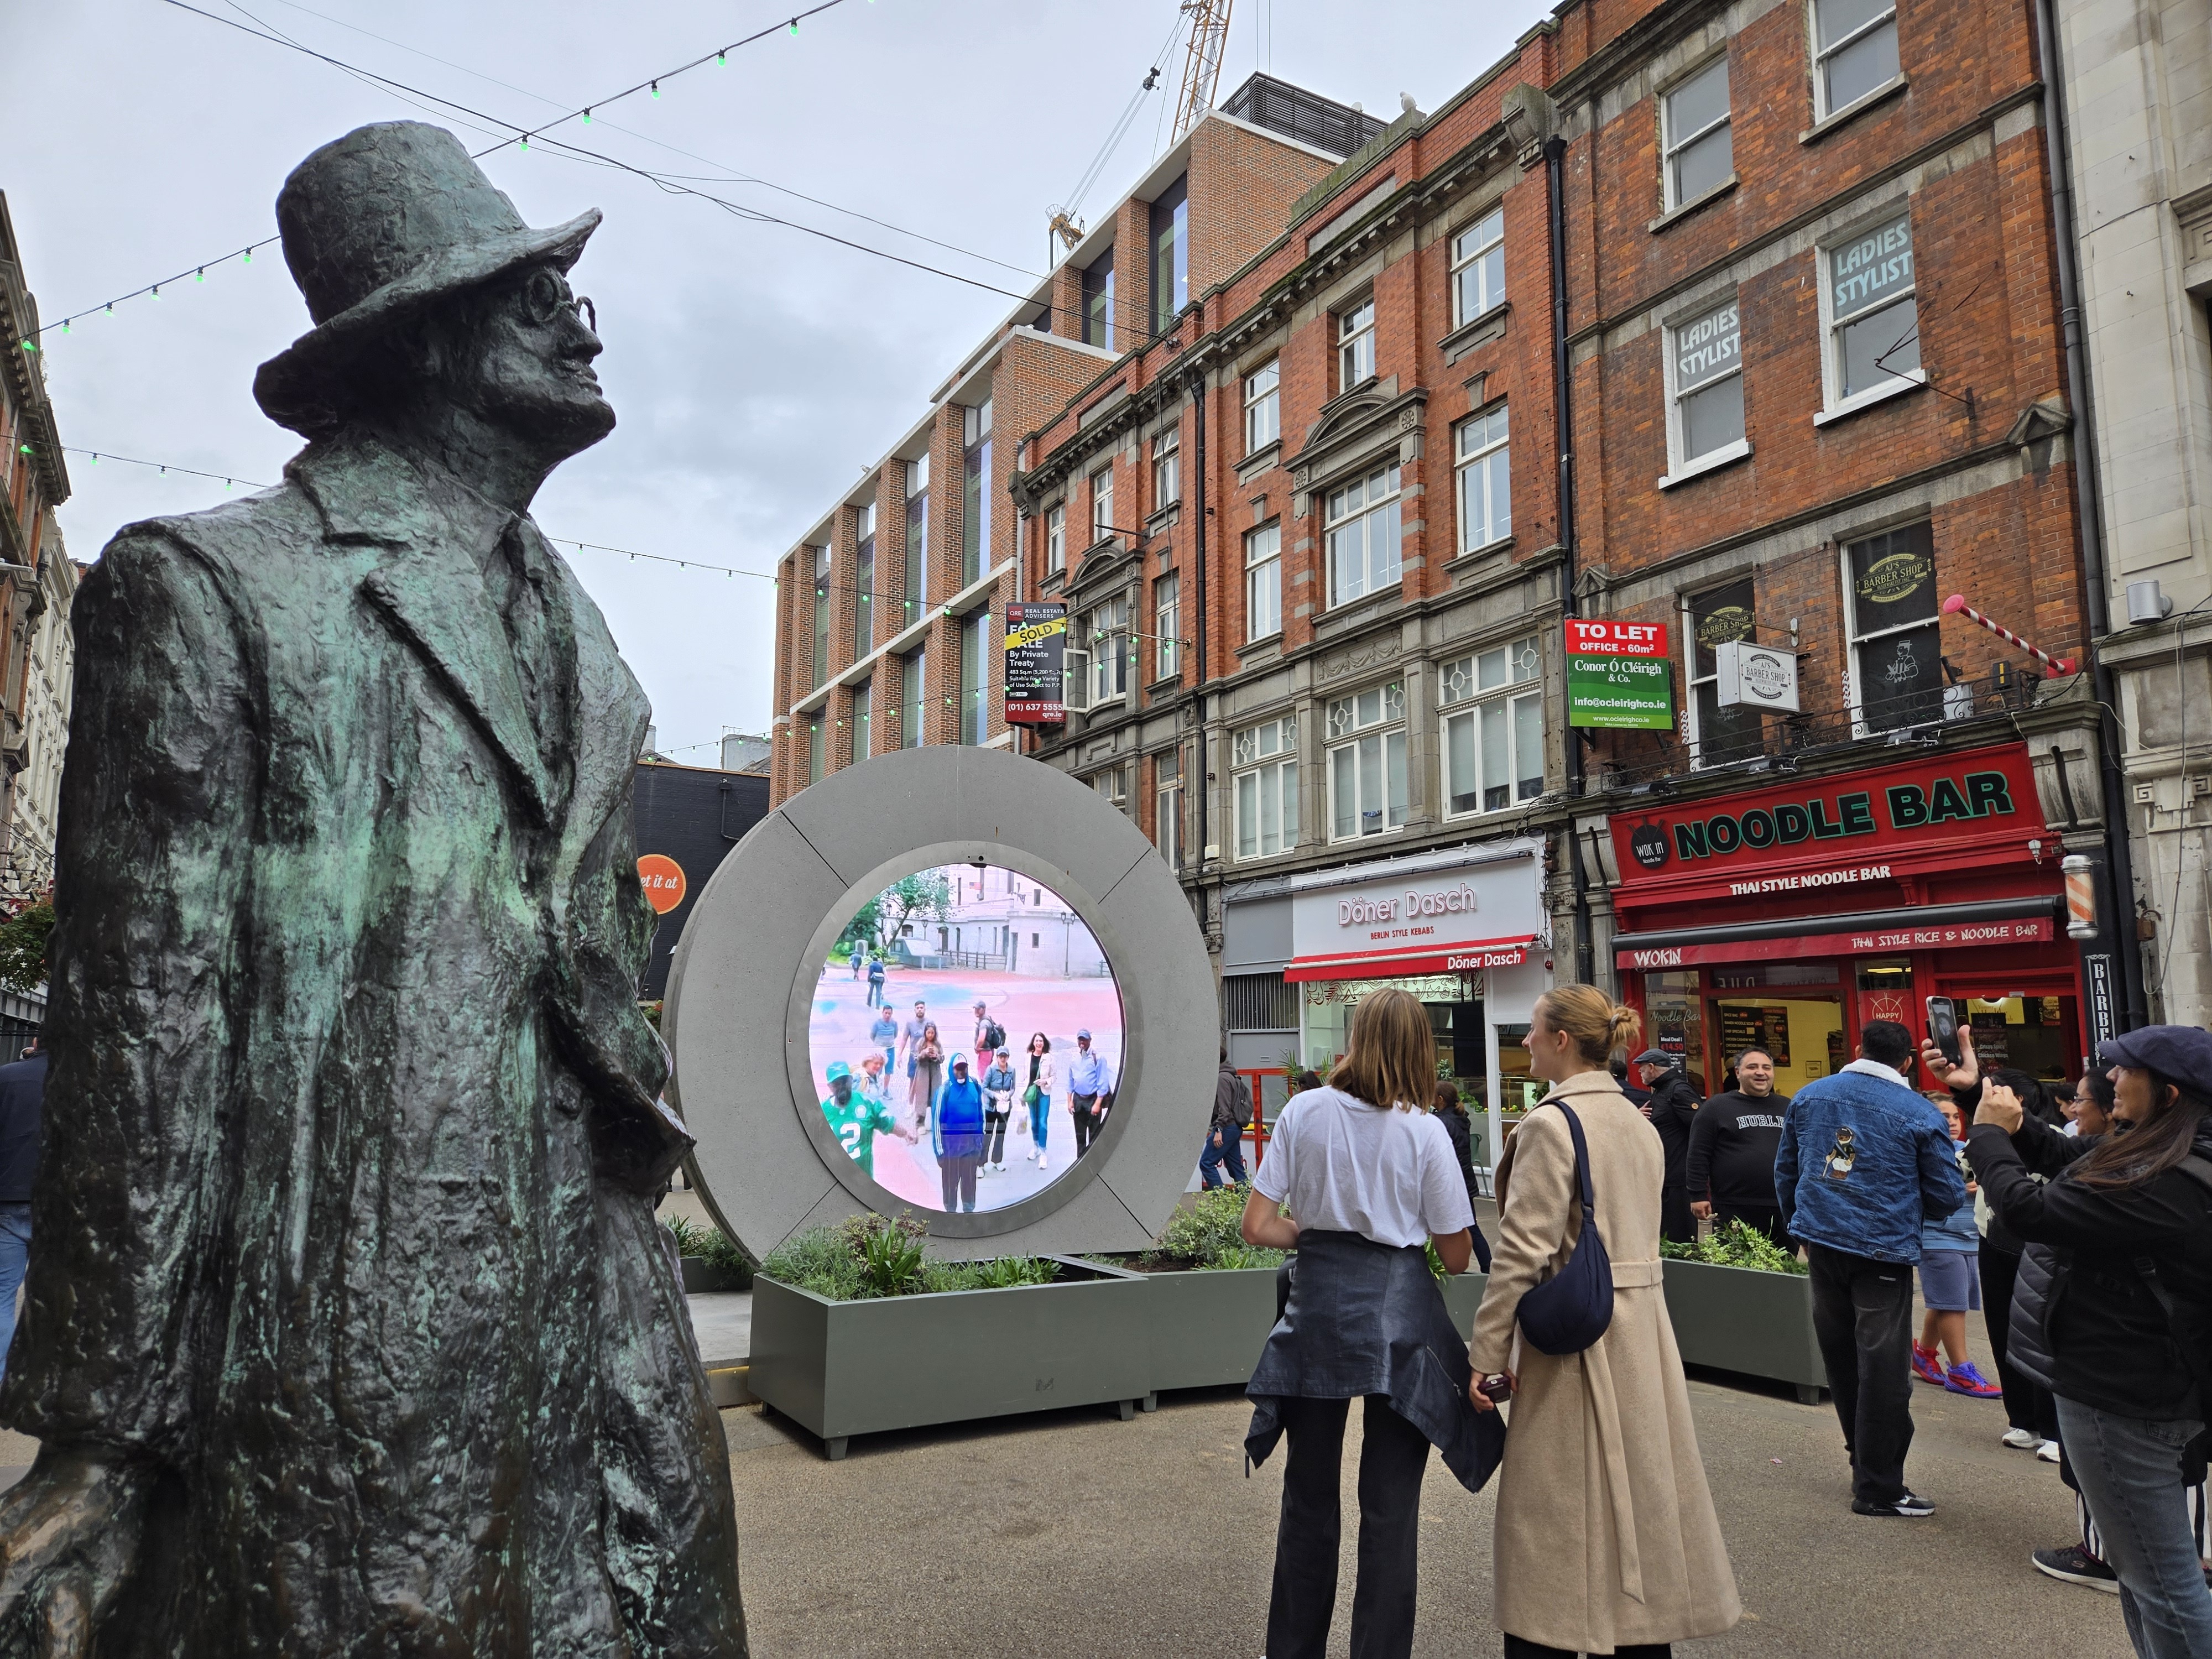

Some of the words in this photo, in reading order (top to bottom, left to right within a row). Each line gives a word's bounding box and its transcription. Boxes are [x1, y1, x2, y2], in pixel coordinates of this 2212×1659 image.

[1837, 222, 1908, 276] LADIES
[1835, 251, 1912, 307] STYLIST
[1680, 305, 1738, 352] LADIES
[1679, 332, 1740, 375] STYLIST
[1885, 561, 1900, 572] AJ'S
[1864, 571, 1897, 589] BARBER
[1900, 563, 1923, 578] SHOP
[1019, 625, 1052, 643] SOLD
[1574, 624, 1606, 638] TO
[1614, 625, 1657, 640] LET
[1701, 622, 1729, 637] BARBER
[1730, 615, 1749, 628] SHOP
[1010, 650, 1019, 659] By
[1580, 643, 1619, 651] OFFICE
[1627, 644, 1654, 653] 60m²
[1009, 659, 1034, 667] Treaty
[1575, 660, 1606, 671] Conor
[1609, 658, 1619, 672] Ó
[1621, 662, 1662, 676] Cléirigh
[1609, 674, 1615, 682] &
[1618, 674, 1631, 682] Co.
[1746, 667, 1770, 680] BARBER
[1771, 672, 1786, 682] SHOP
[1008, 703, 1023, 712] (01)
[1574, 697, 1666, 709] info@ocleirighco.ie
[1673, 791, 1876, 860] NOODLE
[1885, 770, 2015, 829] BAR
[1636, 843, 1654, 857] WOK
[1655, 841, 1664, 854] IN
[653, 874, 664, 888] it
[665, 876, 678, 889] at
[1730, 881, 1760, 895] THAI
[1761, 877, 1799, 892] STYLE
[1801, 869, 1859, 887] NOODLE
[1860, 865, 1891, 880] BAR
[1338, 897, 1397, 926] Döner
[1405, 883, 1477, 917] Dasch
[1370, 931, 1390, 940] BERLIN
[1392, 929, 1408, 938] STYLE
[1411, 926, 1434, 936] KEBABS
[1851, 936, 1873, 948] THAI
[1879, 934, 1910, 946] STYLE
[1914, 931, 1940, 943] RICE
[1945, 931, 1957, 941] &
[1961, 926, 2009, 940] NOODLE
[2016, 925, 2038, 936] BAR
[1448, 955, 1482, 970] Döner
[1484, 952, 1521, 967] Dasch
[1634, 948, 1682, 967] WOKIN
[1650, 1009, 1682, 1022] Noodle
[1683, 1009, 1702, 1025] Bar
[2094, 963, 2110, 1060] BARBE
